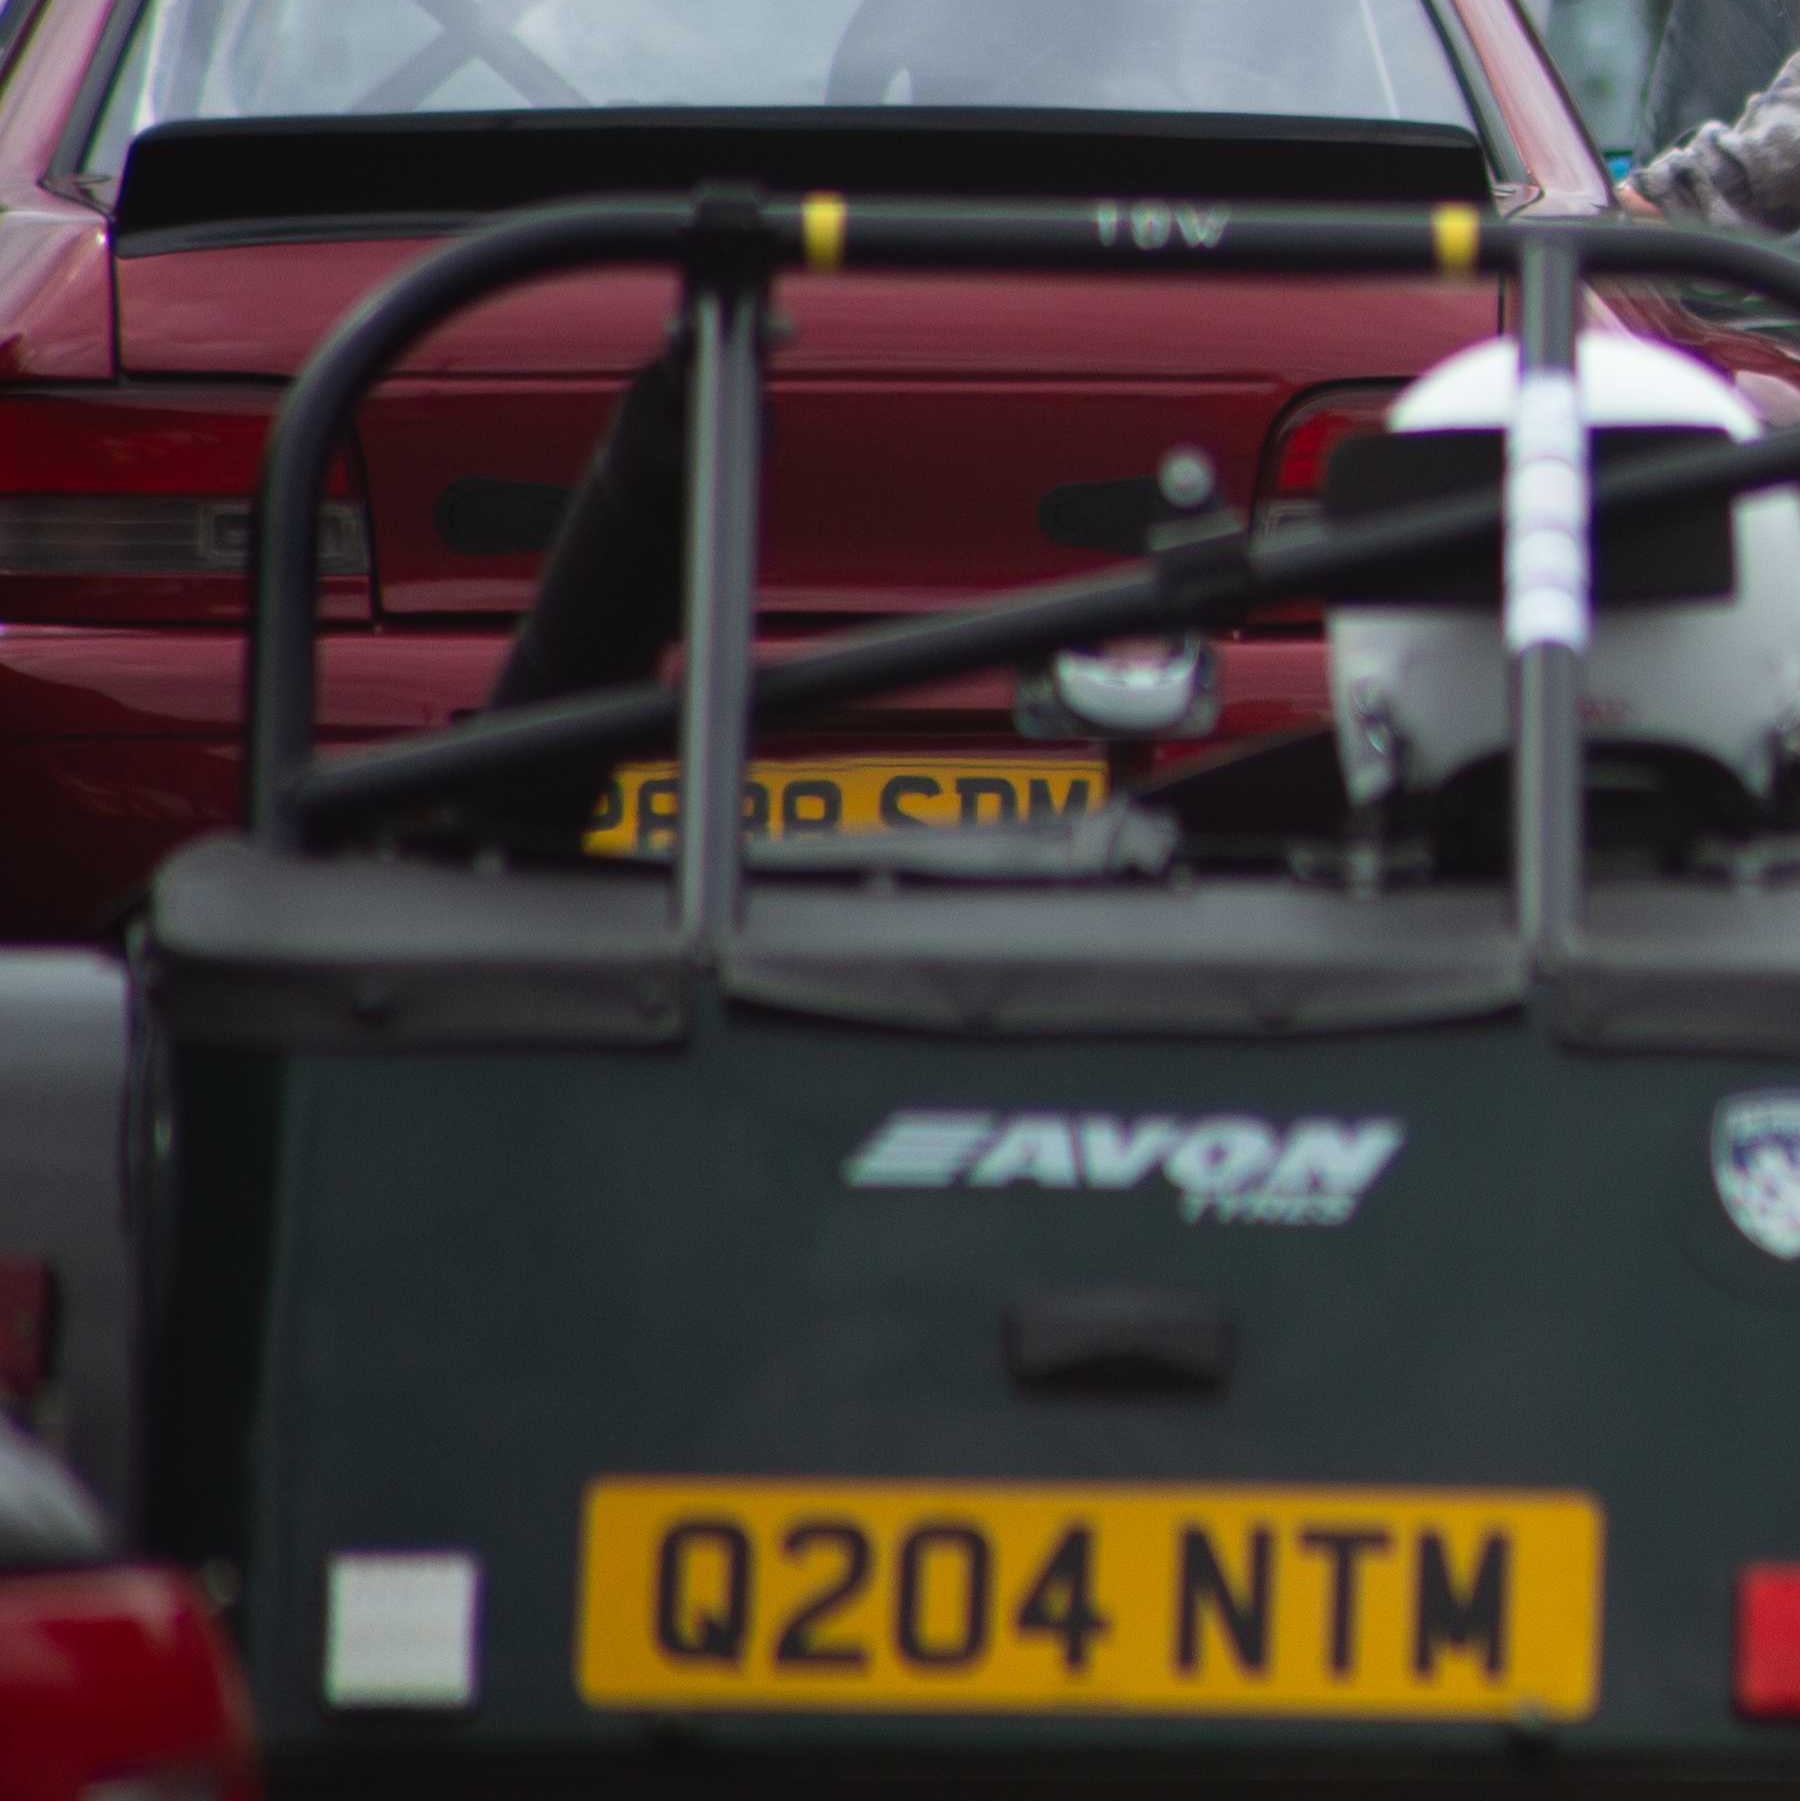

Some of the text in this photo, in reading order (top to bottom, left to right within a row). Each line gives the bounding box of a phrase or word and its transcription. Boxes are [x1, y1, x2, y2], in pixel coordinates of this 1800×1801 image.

[967, 1112, 1404, 1194] AVON
[654, 1518, 1513, 1685] Q204 NTM
